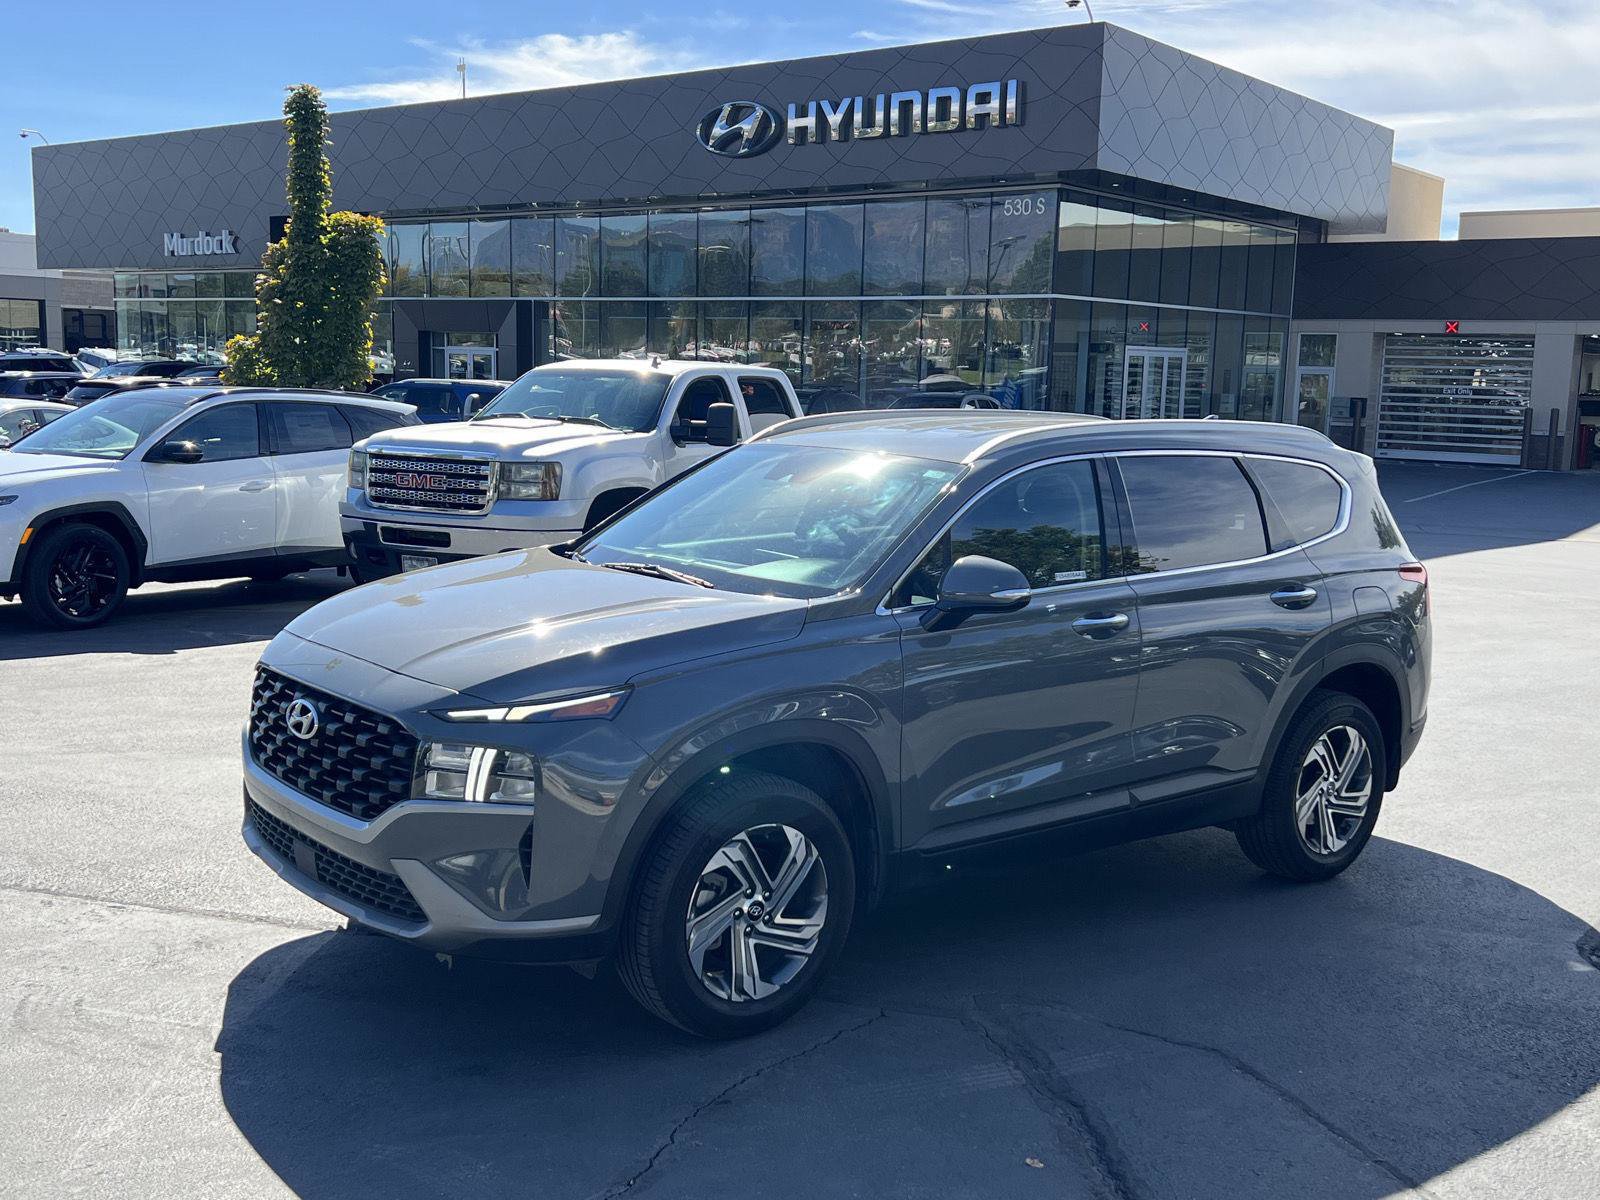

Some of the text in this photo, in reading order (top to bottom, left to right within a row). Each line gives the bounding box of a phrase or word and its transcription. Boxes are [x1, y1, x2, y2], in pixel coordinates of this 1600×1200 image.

[787, 79, 1020, 145] HYUNDAI
[1003, 197, 1046, 216] 530 S
[163, 229, 237, 257] Murdock
[1457, 387, 1473, 397] Only
[395, 472, 446, 490] GMC
